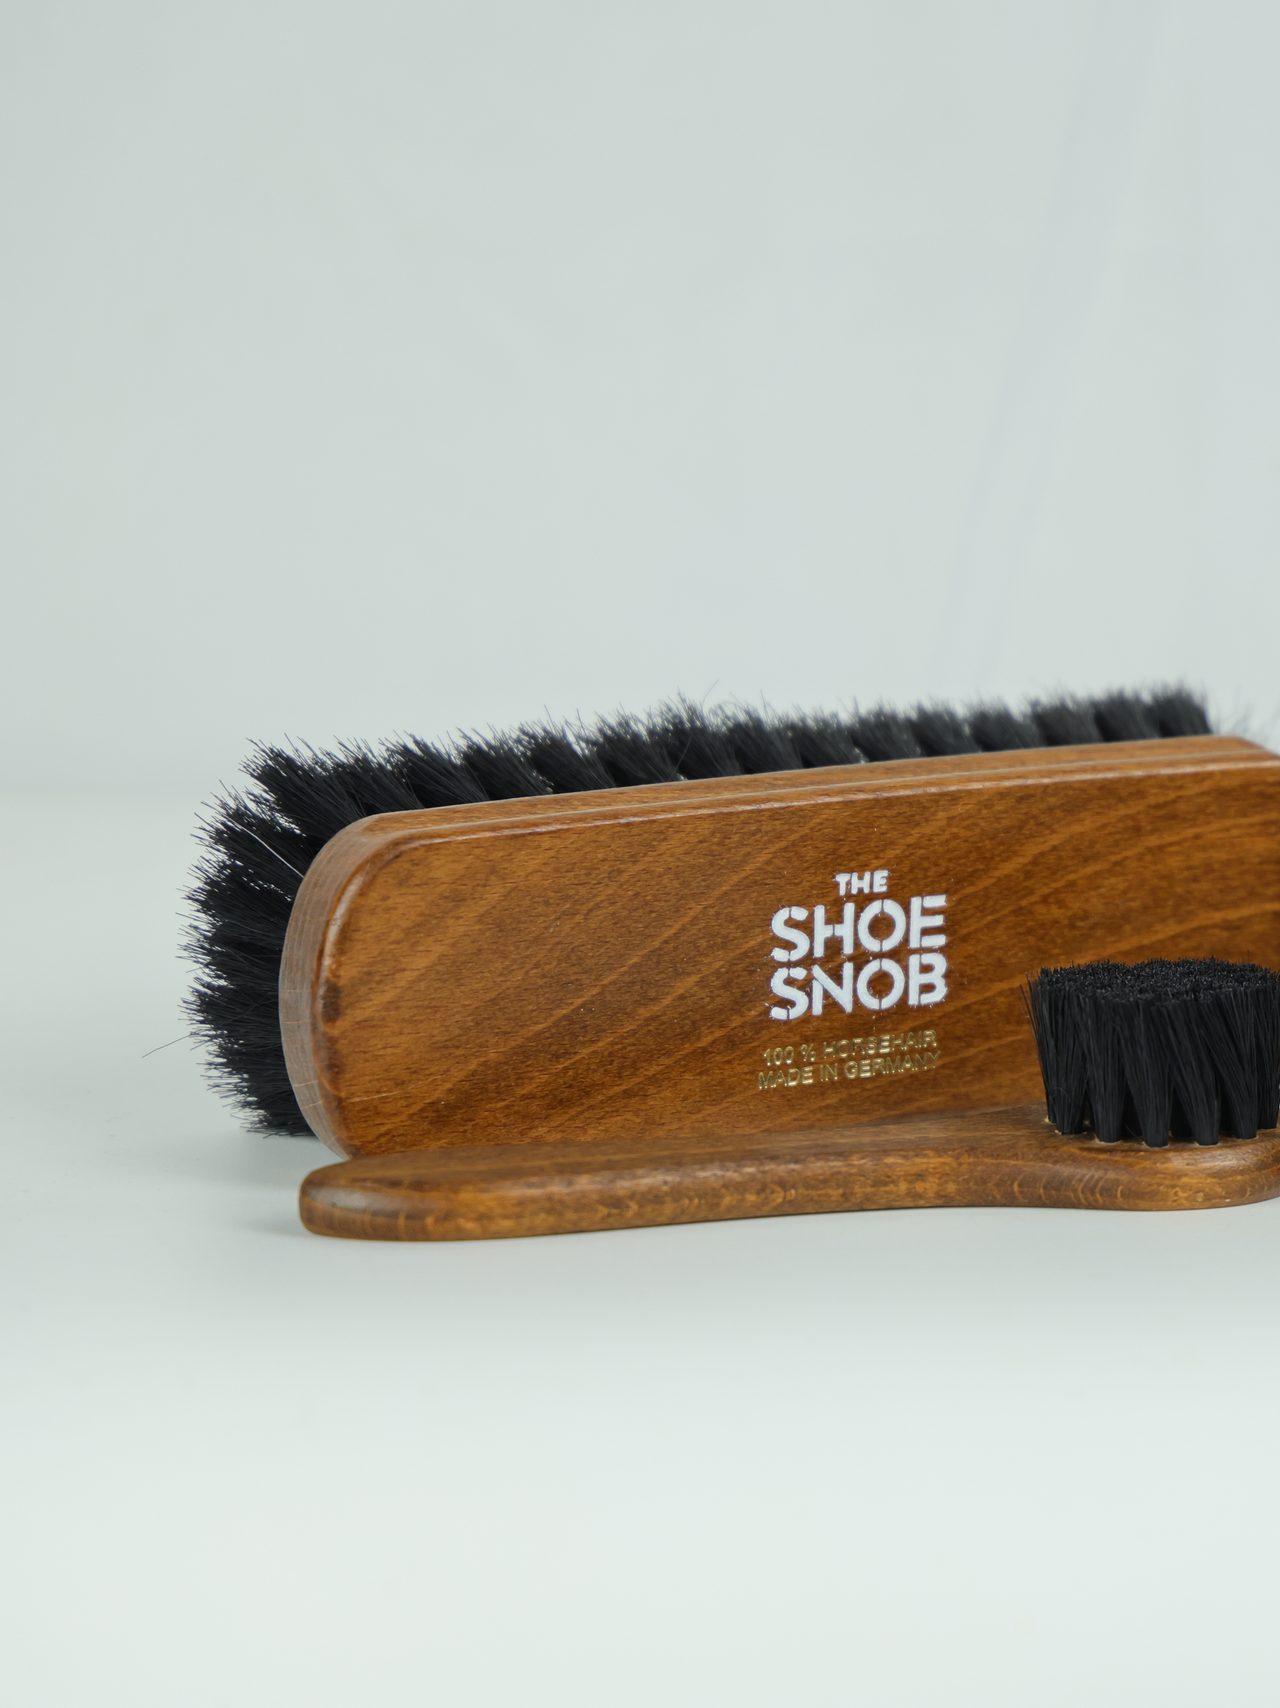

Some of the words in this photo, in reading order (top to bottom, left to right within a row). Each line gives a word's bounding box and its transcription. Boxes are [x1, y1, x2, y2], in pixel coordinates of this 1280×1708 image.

[835, 870, 889, 895] THE
[770, 894, 948, 962] SHOE
[769, 952, 948, 1020] SNOB
[763, 1045, 795, 1066] 100
[800, 1042, 817, 1063] %
[823, 1029, 937, 1059] HORSEHAIR
[757, 1065, 814, 1089] MADE
[820, 1062, 838, 1082] IN
[844, 1050, 941, 1079] GERMANY
